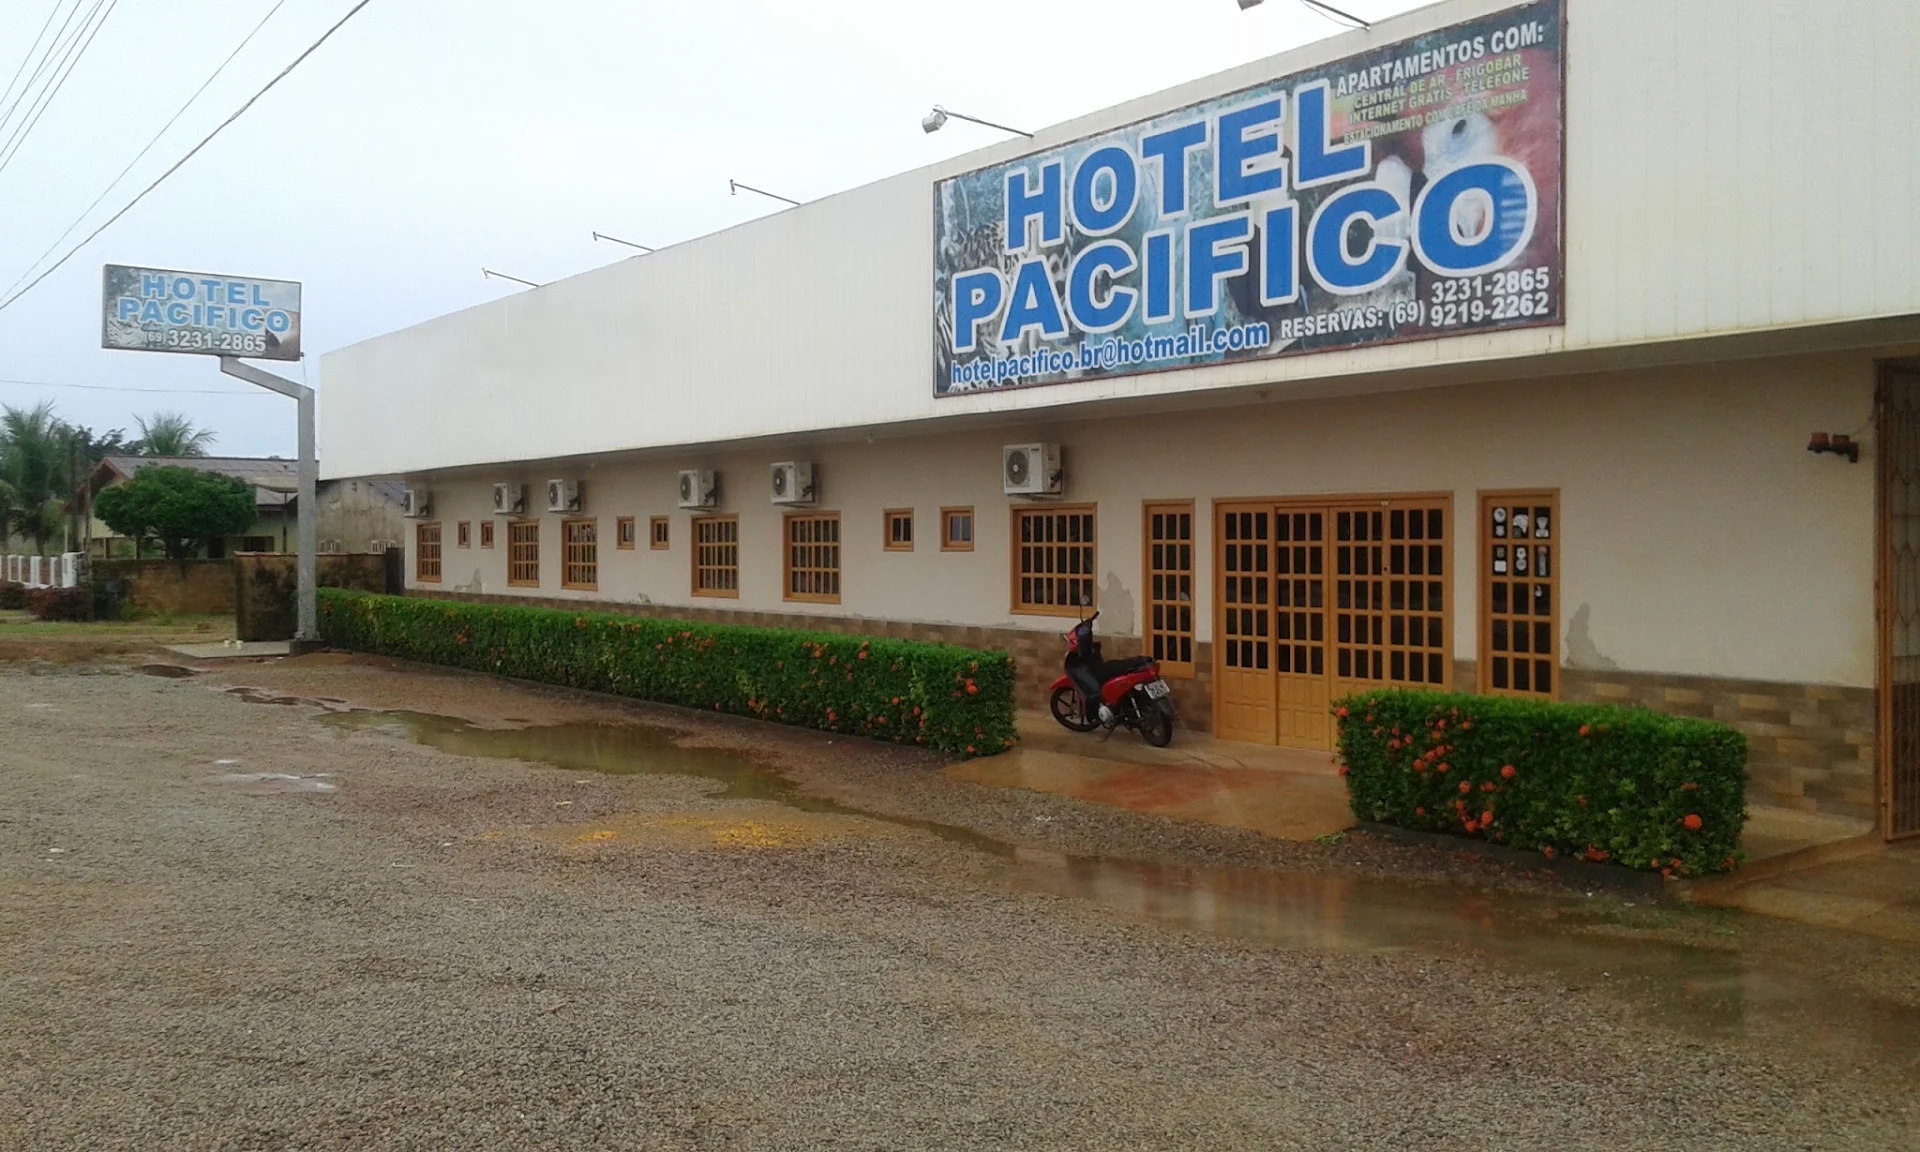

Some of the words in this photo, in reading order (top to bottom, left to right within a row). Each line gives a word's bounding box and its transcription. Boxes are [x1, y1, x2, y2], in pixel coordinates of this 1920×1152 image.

[1336, 36, 1485, 98] APARTAMENTOS
[1491, 21, 1543, 53] COM:
[1354, 85, 1406, 109] CENTRAL
[1410, 79, 1426, 94] DE
[1429, 74, 1446, 90] AR
[1456, 53, 1522, 81] FRIGOBAR
[1349, 99, 1405, 124] INTERNET
[1463, 66, 1530, 95] TELEFONE
[1344, 114, 1424, 145] ESTACIONAMENTO
[1003, 78, 1371, 256] HOTEL
[952, 156, 1538, 353] PACIFICO
[140, 272, 271, 308] HOTEL
[1431, 267, 1549, 304] 3231-2865
[117, 297, 292, 334] PACIFICO
[146, 330, 167, 344] (69)
[168, 329, 267, 352] 3231-2865
[1281, 310, 1384, 339] RESERVAS:
[1388, 300, 1425, 331] (69)
[1430, 291, 1549, 327] 9219-2262
[951, 321, 1269, 384] hotelpacifico.br@hotmail.com
